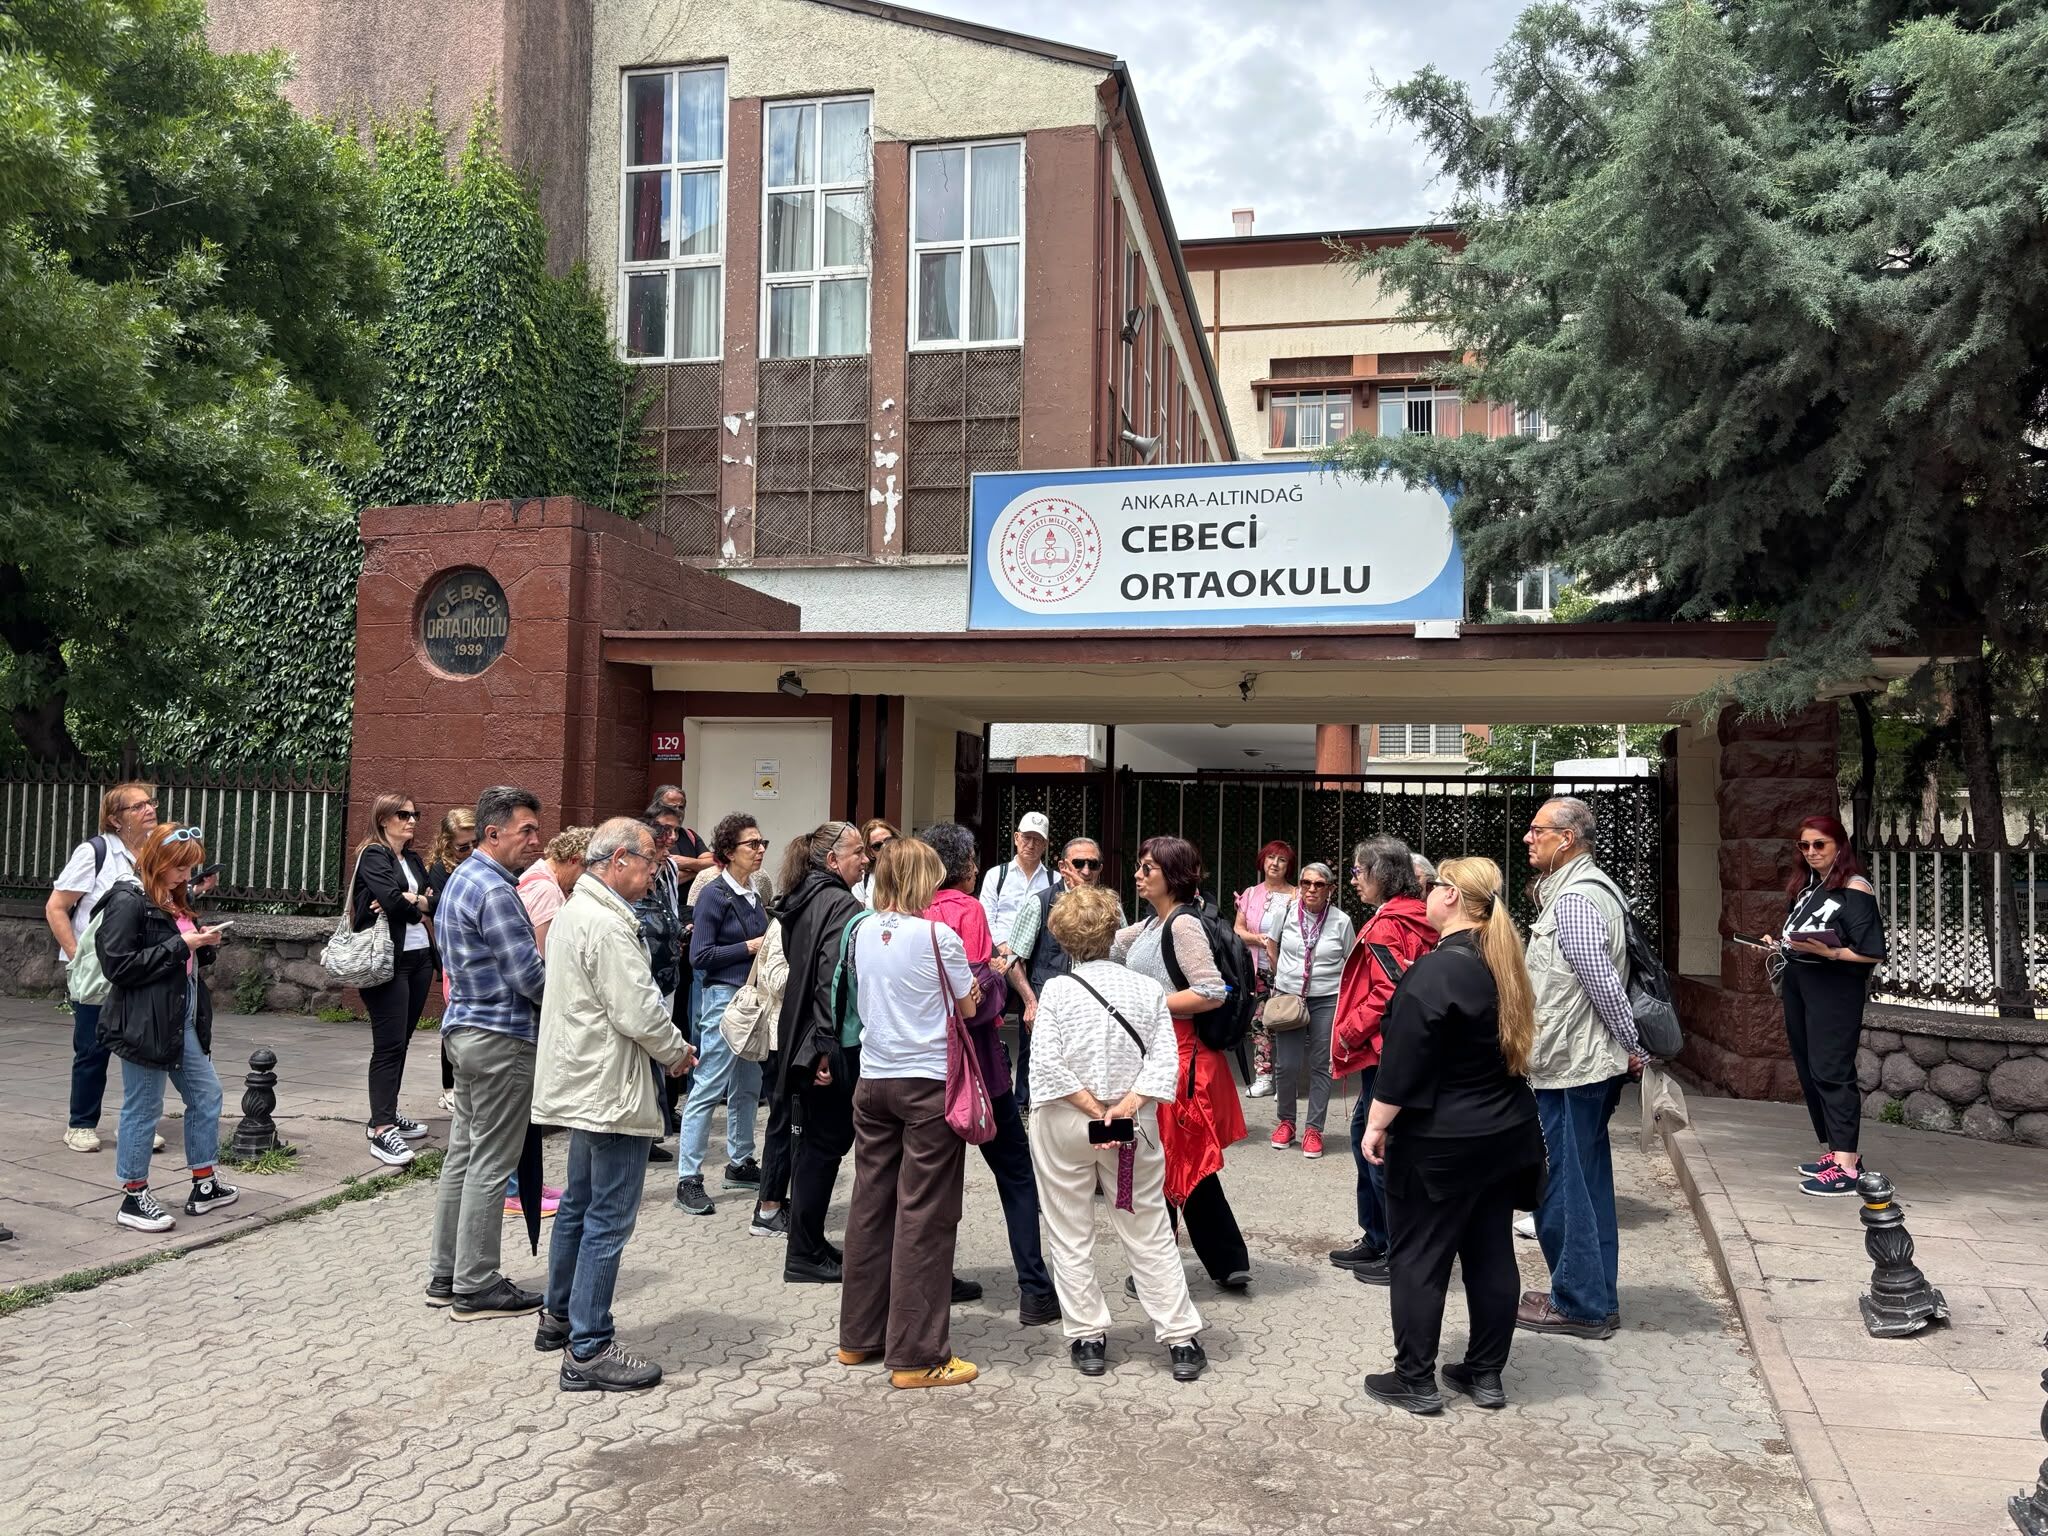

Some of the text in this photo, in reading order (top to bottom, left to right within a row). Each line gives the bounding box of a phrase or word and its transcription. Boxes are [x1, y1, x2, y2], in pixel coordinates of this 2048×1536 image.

[1121, 484, 1303, 511] ANKARA-ALTINDAĞ
[1121, 513, 1257, 554] CEBECİ
[1120, 565, 1371, 601] ORTAOKULU
[427, 616, 507, 639] ORTAOKULU
[455, 643, 483, 656] 1939
[657, 736, 680, 750] 129
